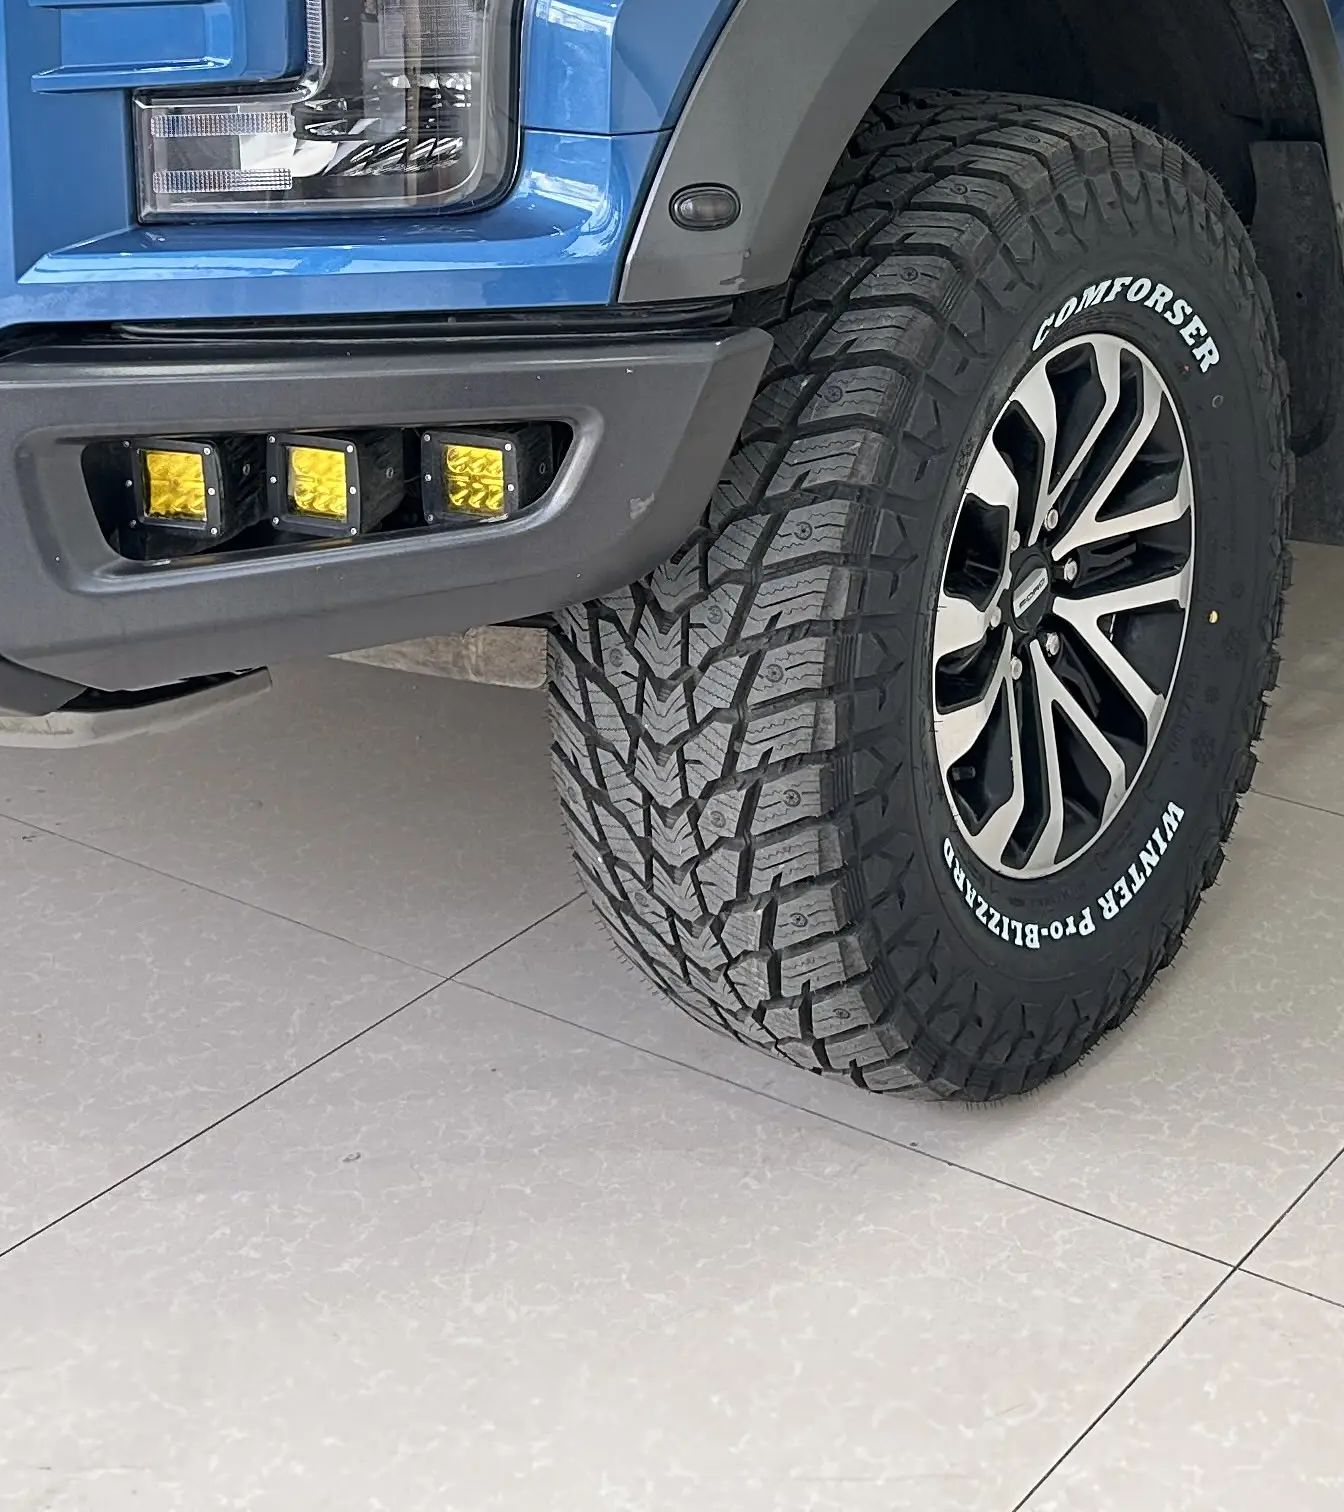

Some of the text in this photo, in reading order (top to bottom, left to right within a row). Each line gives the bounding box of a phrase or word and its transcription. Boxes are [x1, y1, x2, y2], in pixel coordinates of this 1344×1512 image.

[1032, 276, 1221, 373] COMFORSER
[943, 801, 1185, 949] WINTER Pro-BLIZZARD
